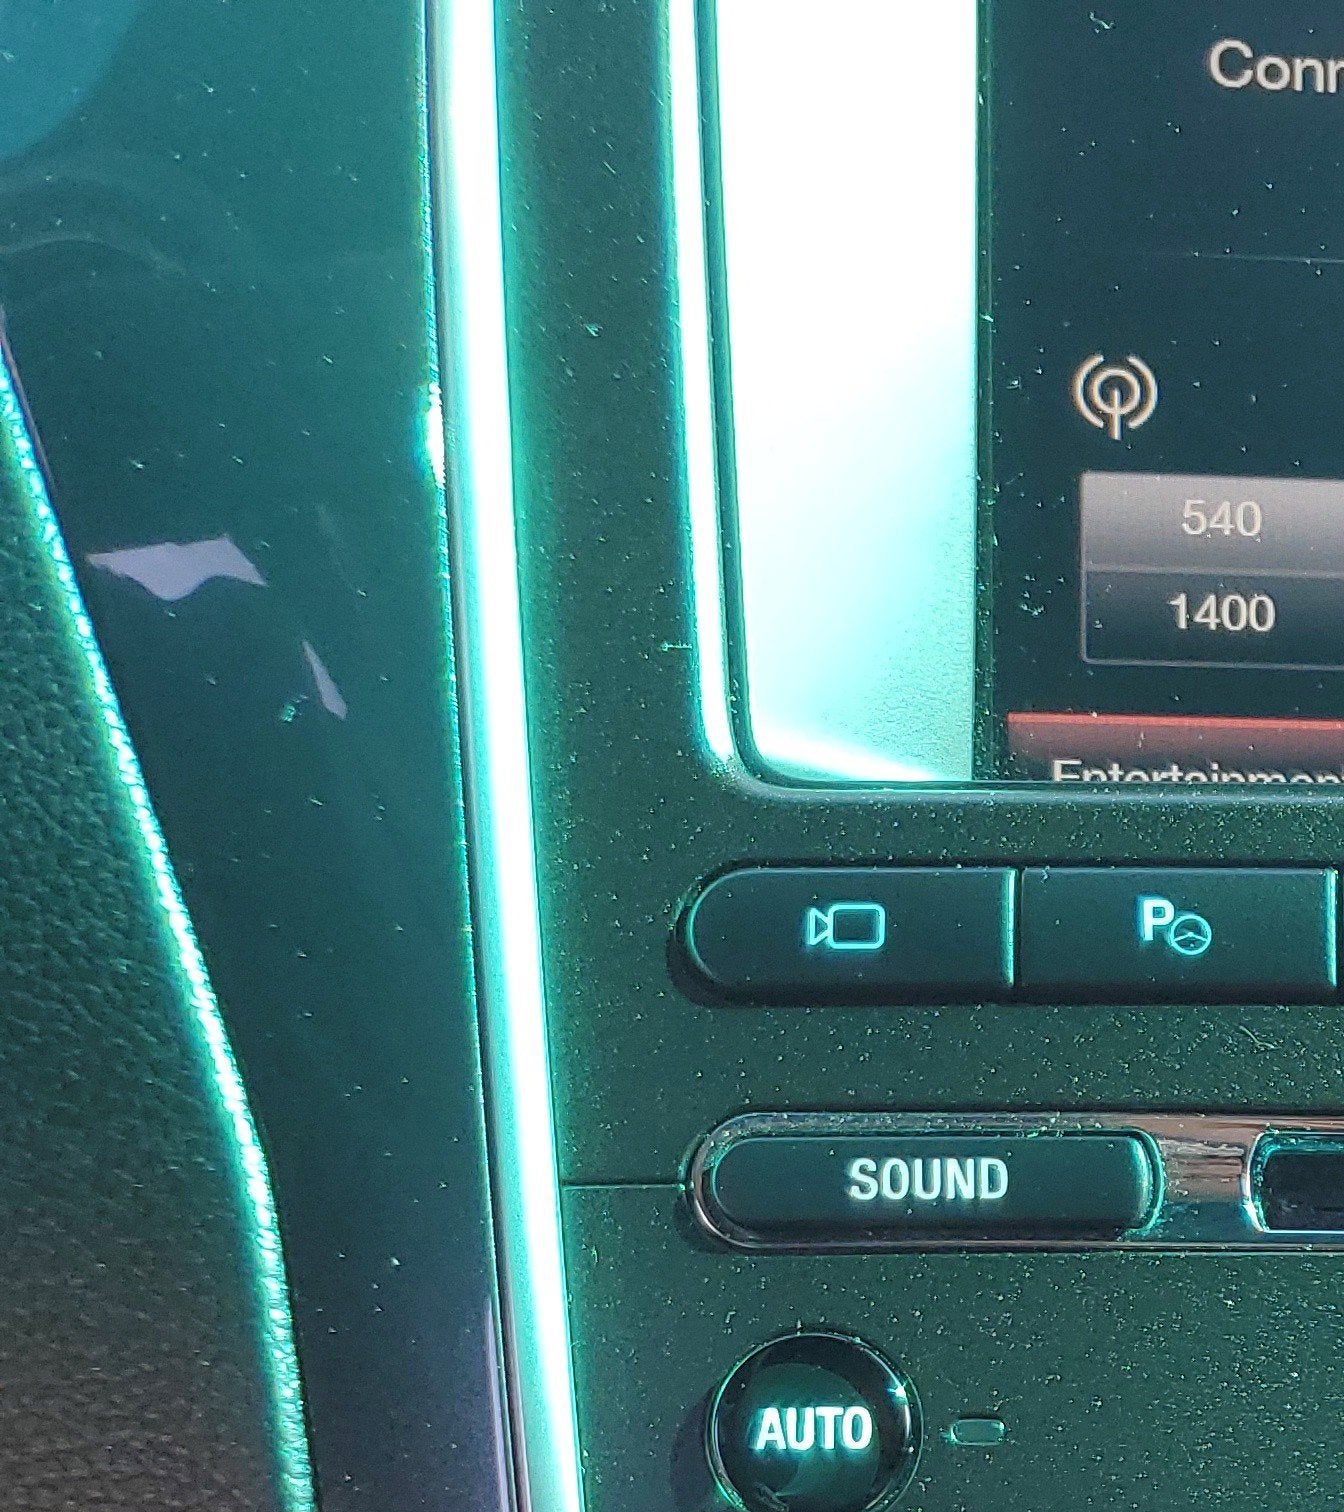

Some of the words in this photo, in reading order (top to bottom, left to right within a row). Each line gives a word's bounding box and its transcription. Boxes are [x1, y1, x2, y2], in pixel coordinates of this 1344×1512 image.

[1181, 499, 1263, 538] 540
[1168, 594, 1277, 633] 1400
[1143, 898, 1174, 942] P
[848, 1157, 1009, 1202] SOUND
[754, 1406, 873, 1453] AUTO
